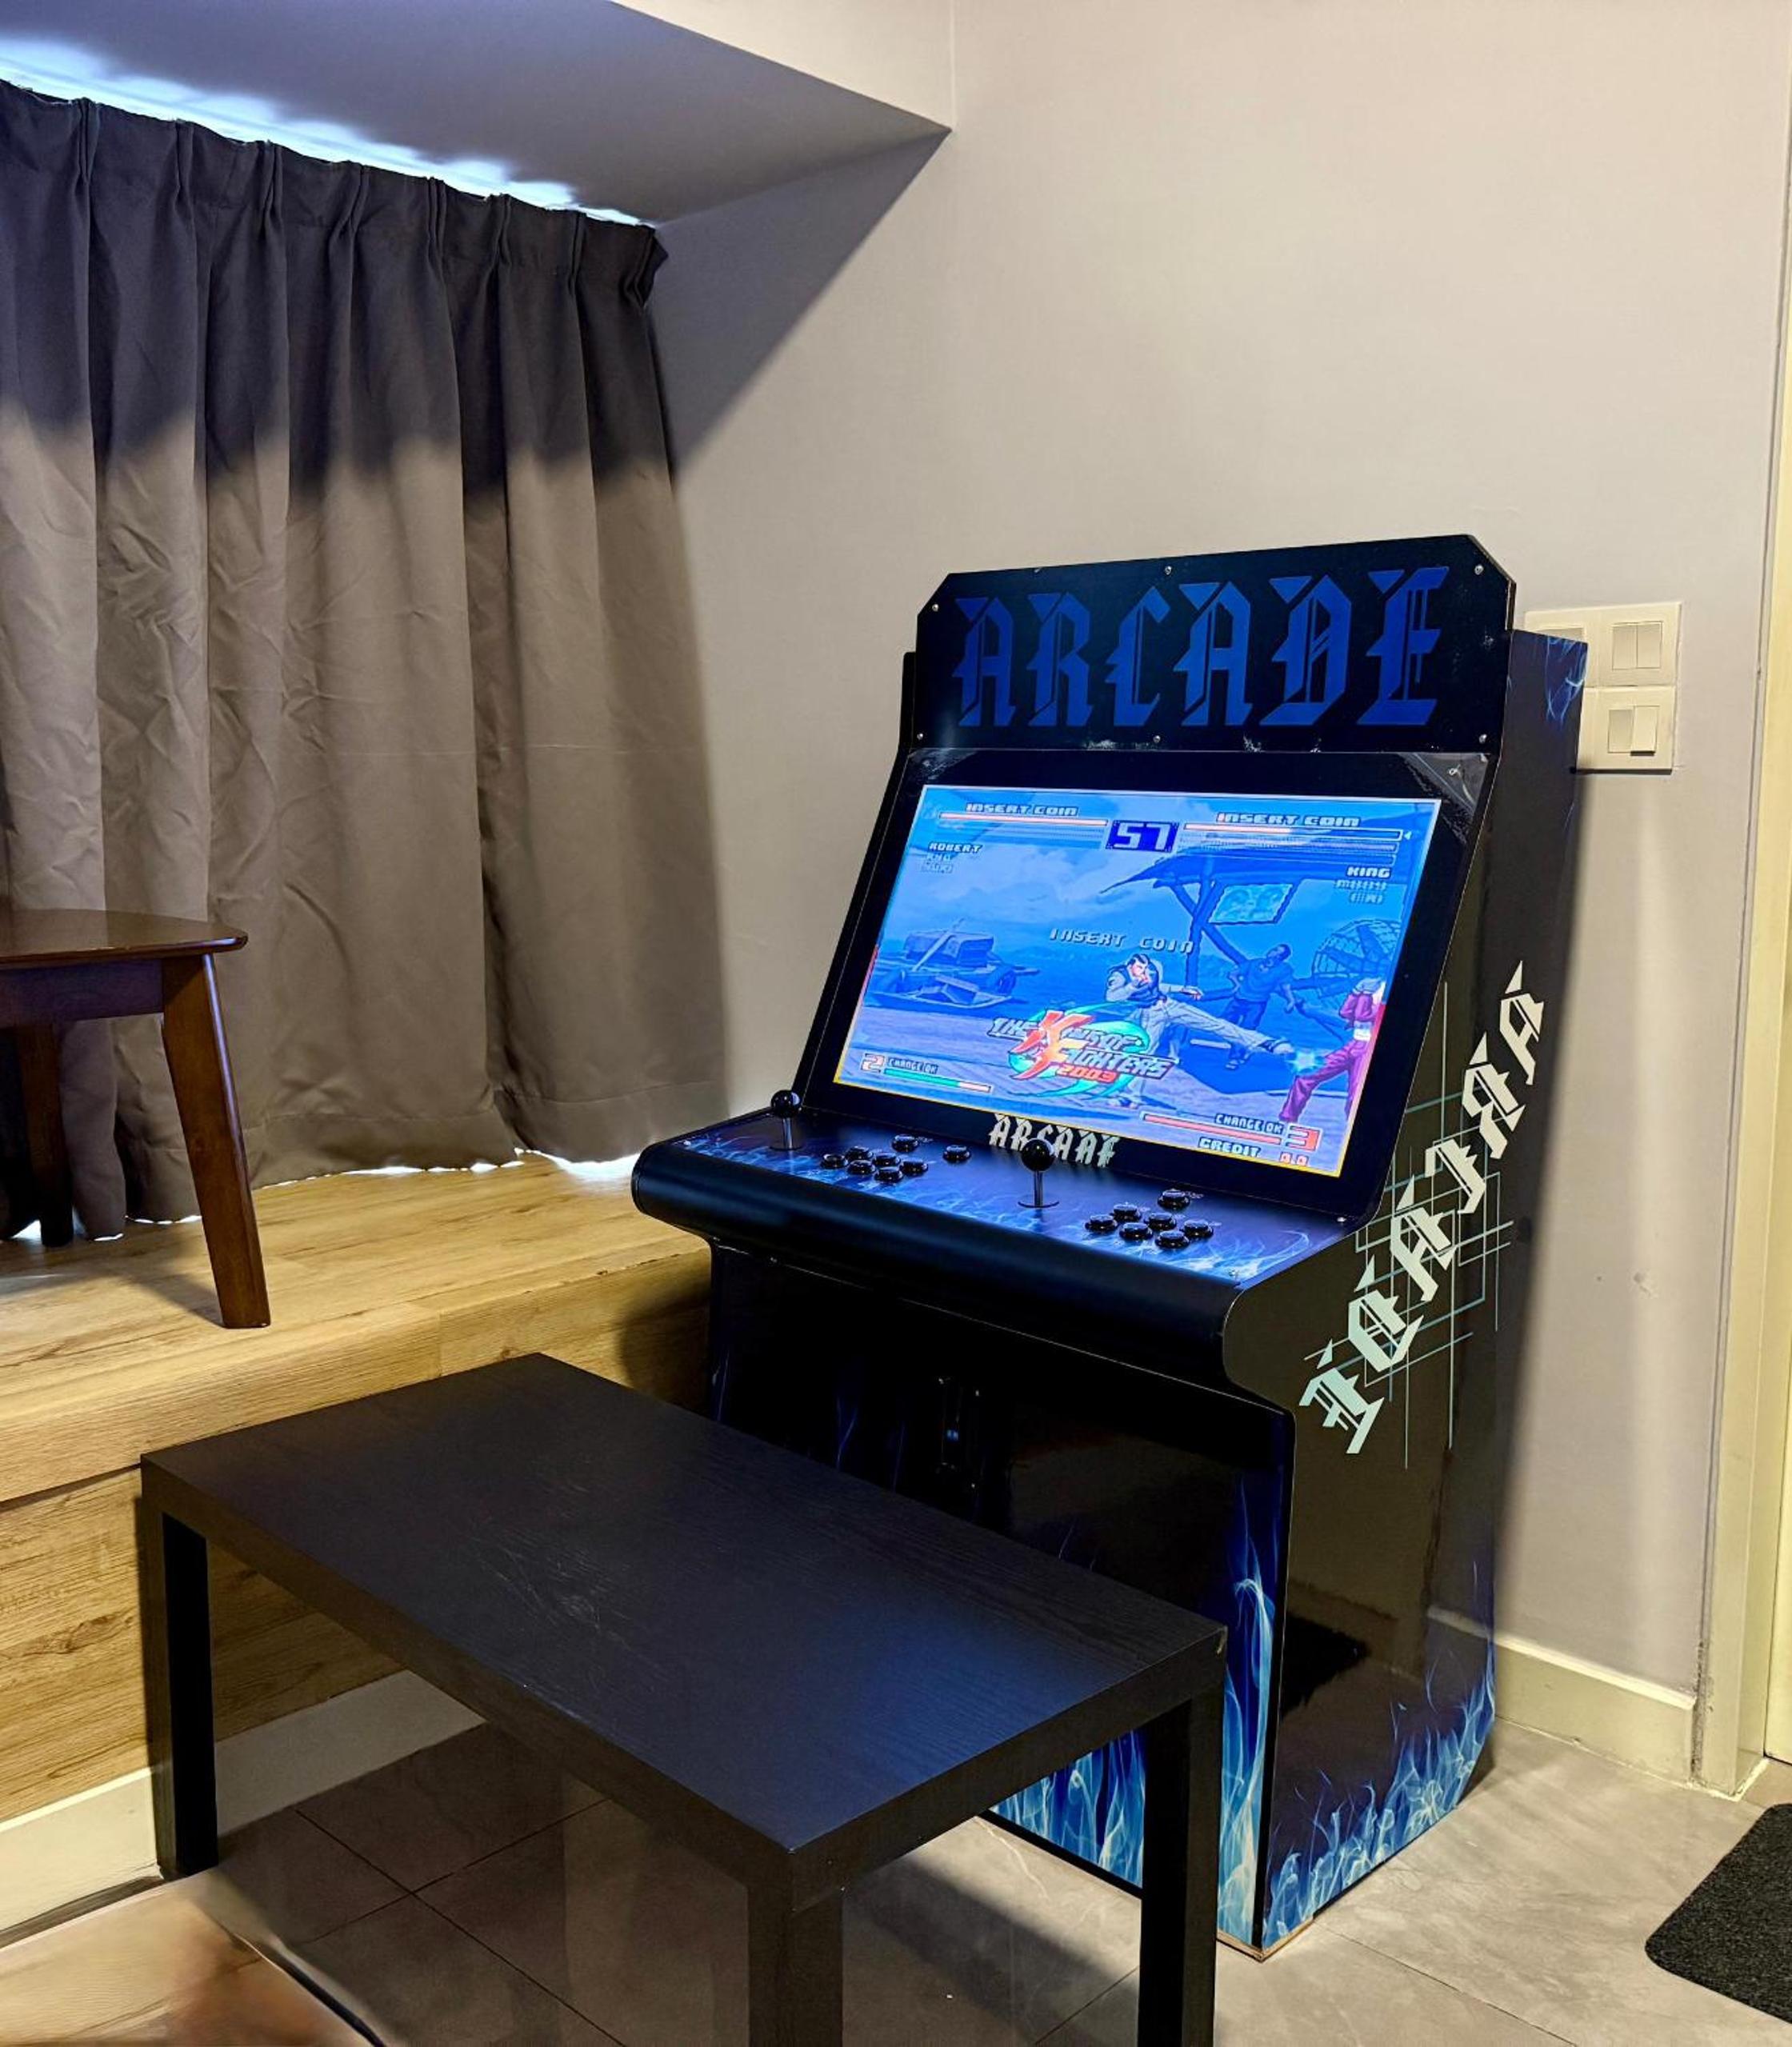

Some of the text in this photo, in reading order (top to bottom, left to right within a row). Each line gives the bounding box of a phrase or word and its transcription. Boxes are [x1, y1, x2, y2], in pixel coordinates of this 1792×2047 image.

[952, 566, 1450, 726] ARCADE
[966, 802, 1078, 816] INSERT COIN
[1217, 813, 1360, 827] INSERT COIN
[1114, 822, 1170, 850] 57
[929, 842, 982, 853] ROBERT
[1346, 866, 1391, 878] KING
[1050, 928, 1194, 954] INSERT COIN
[1215, 1113, 1264, 1132] CHANGE
[1265, 1121, 1284, 1134] OK
[1199, 1137, 1261, 1157] CREDIT
